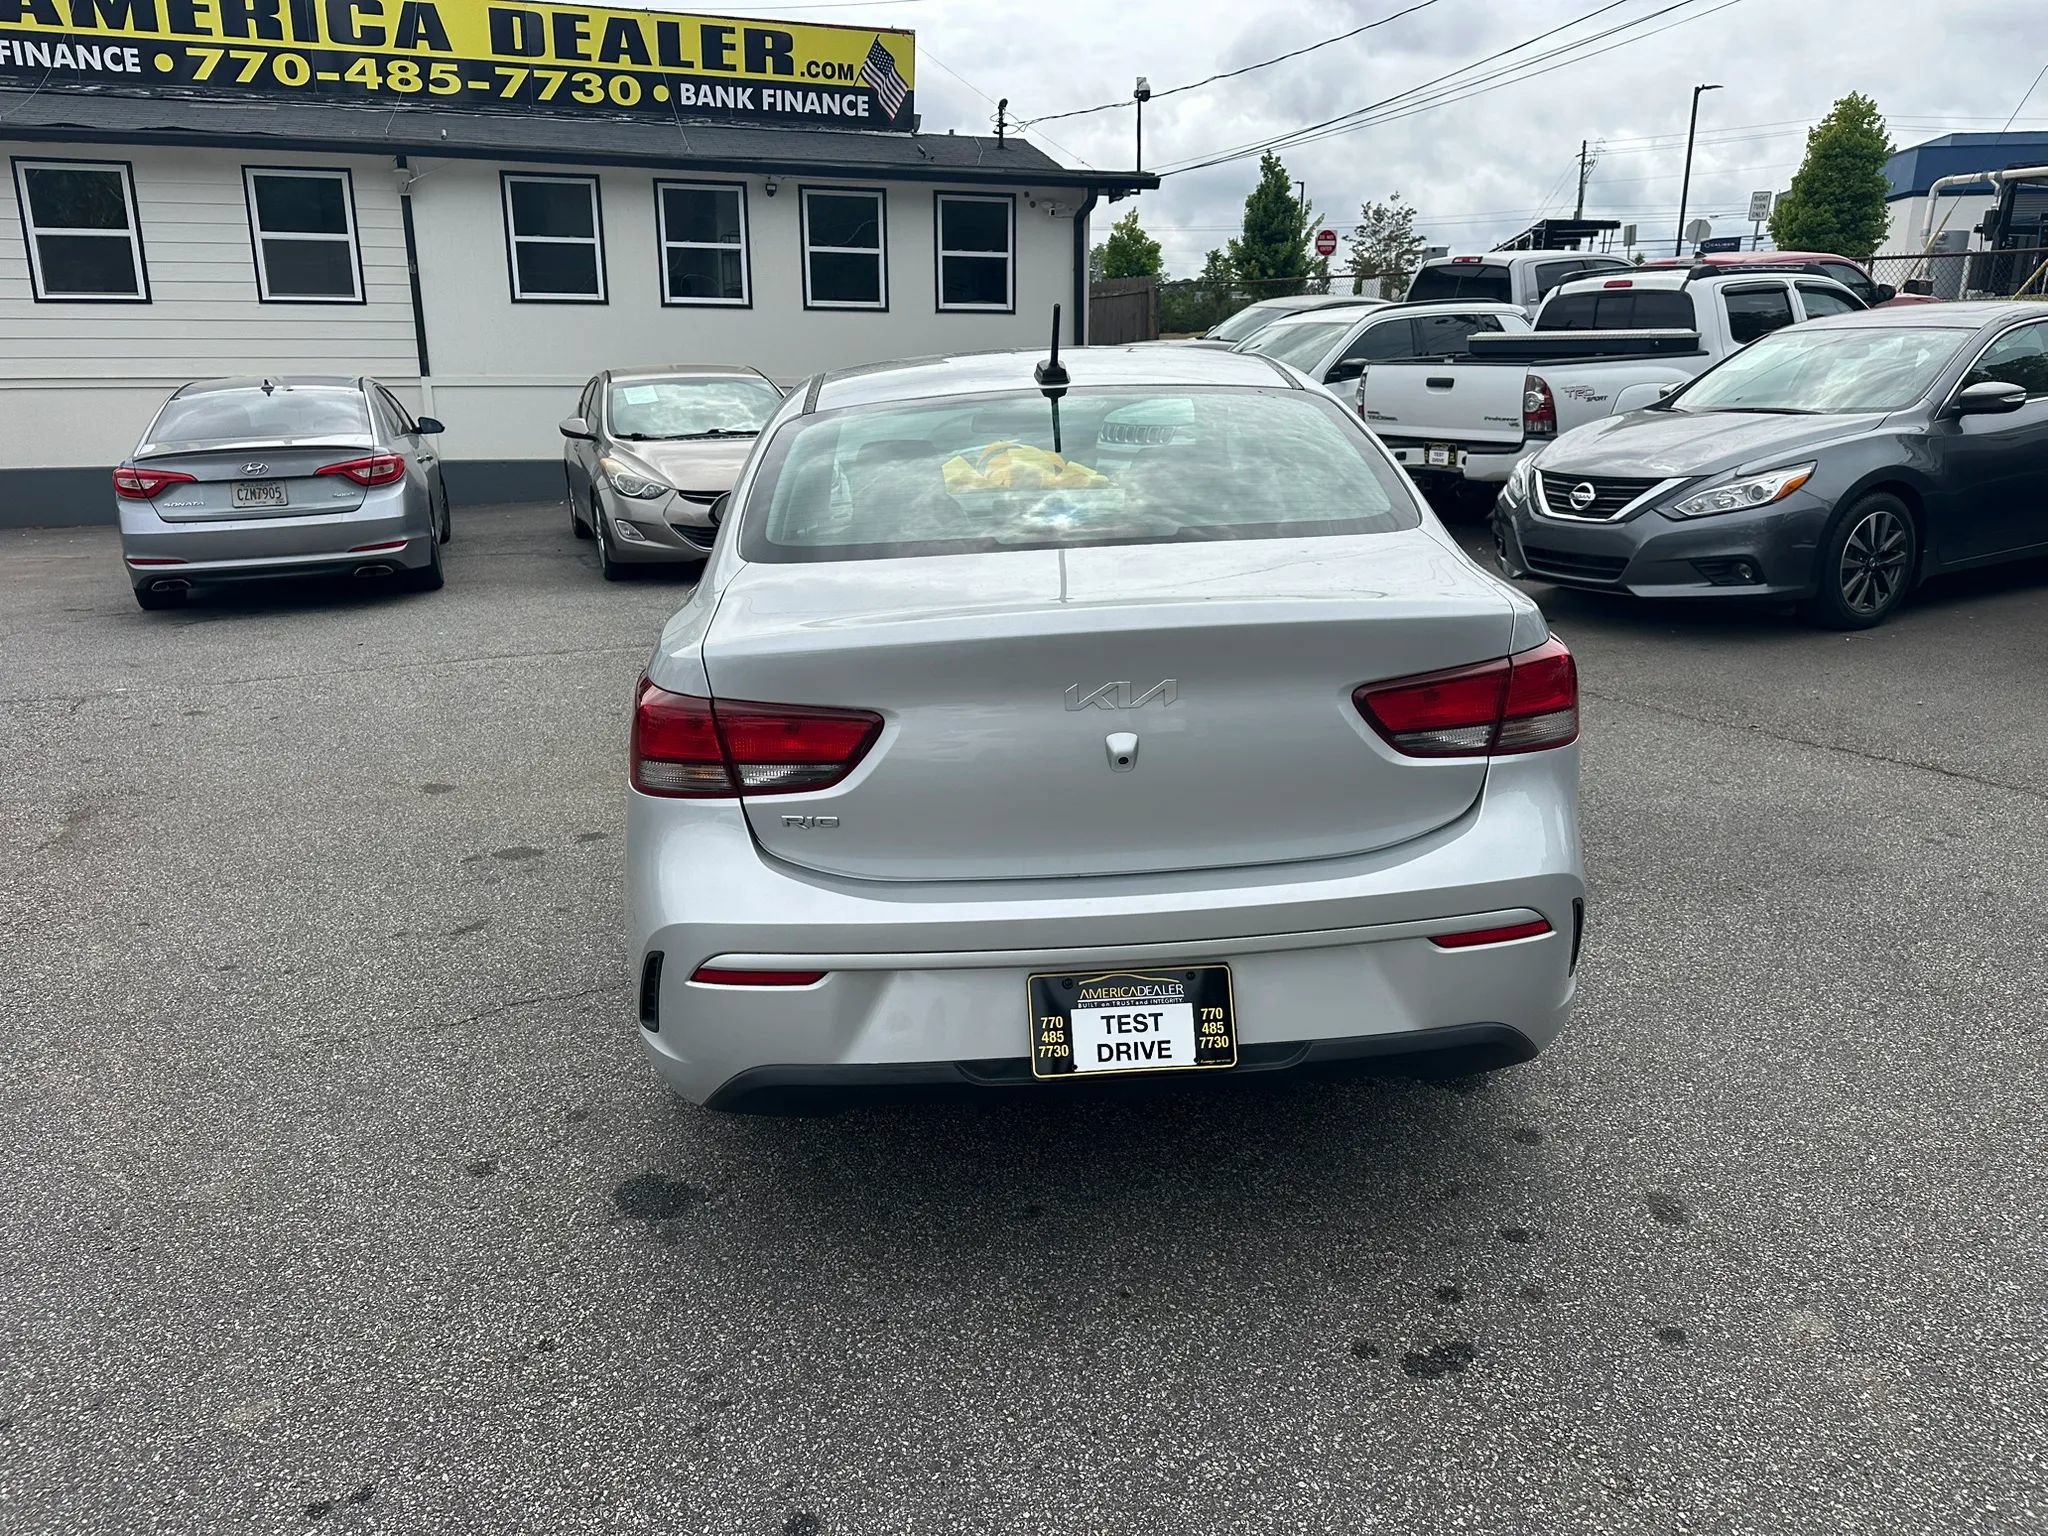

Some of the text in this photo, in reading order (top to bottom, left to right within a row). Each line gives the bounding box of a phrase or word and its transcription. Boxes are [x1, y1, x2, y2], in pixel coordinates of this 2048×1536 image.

[0, 39, 870, 118] FINANCE 770-485-7730 BANK FINANCE
[236, 486, 282, 501] CZM7905
[1064, 678, 1178, 712] KIA
[780, 814, 841, 831] RIO
[1077, 1001, 1098, 1009] BUILT
[1200, 1007, 1224, 1021] 770
[1040, 1015, 1064, 1029] 770
[1100, 1012, 1164, 1035] TEST
[1201, 1021, 1225, 1034] 485
[1041, 1030, 1065, 1044] 485
[1199, 1035, 1230, 1049] 7730
[1038, 1044, 1070, 1059] 7730
[1097, 1039, 1173, 1063] DRIVE
